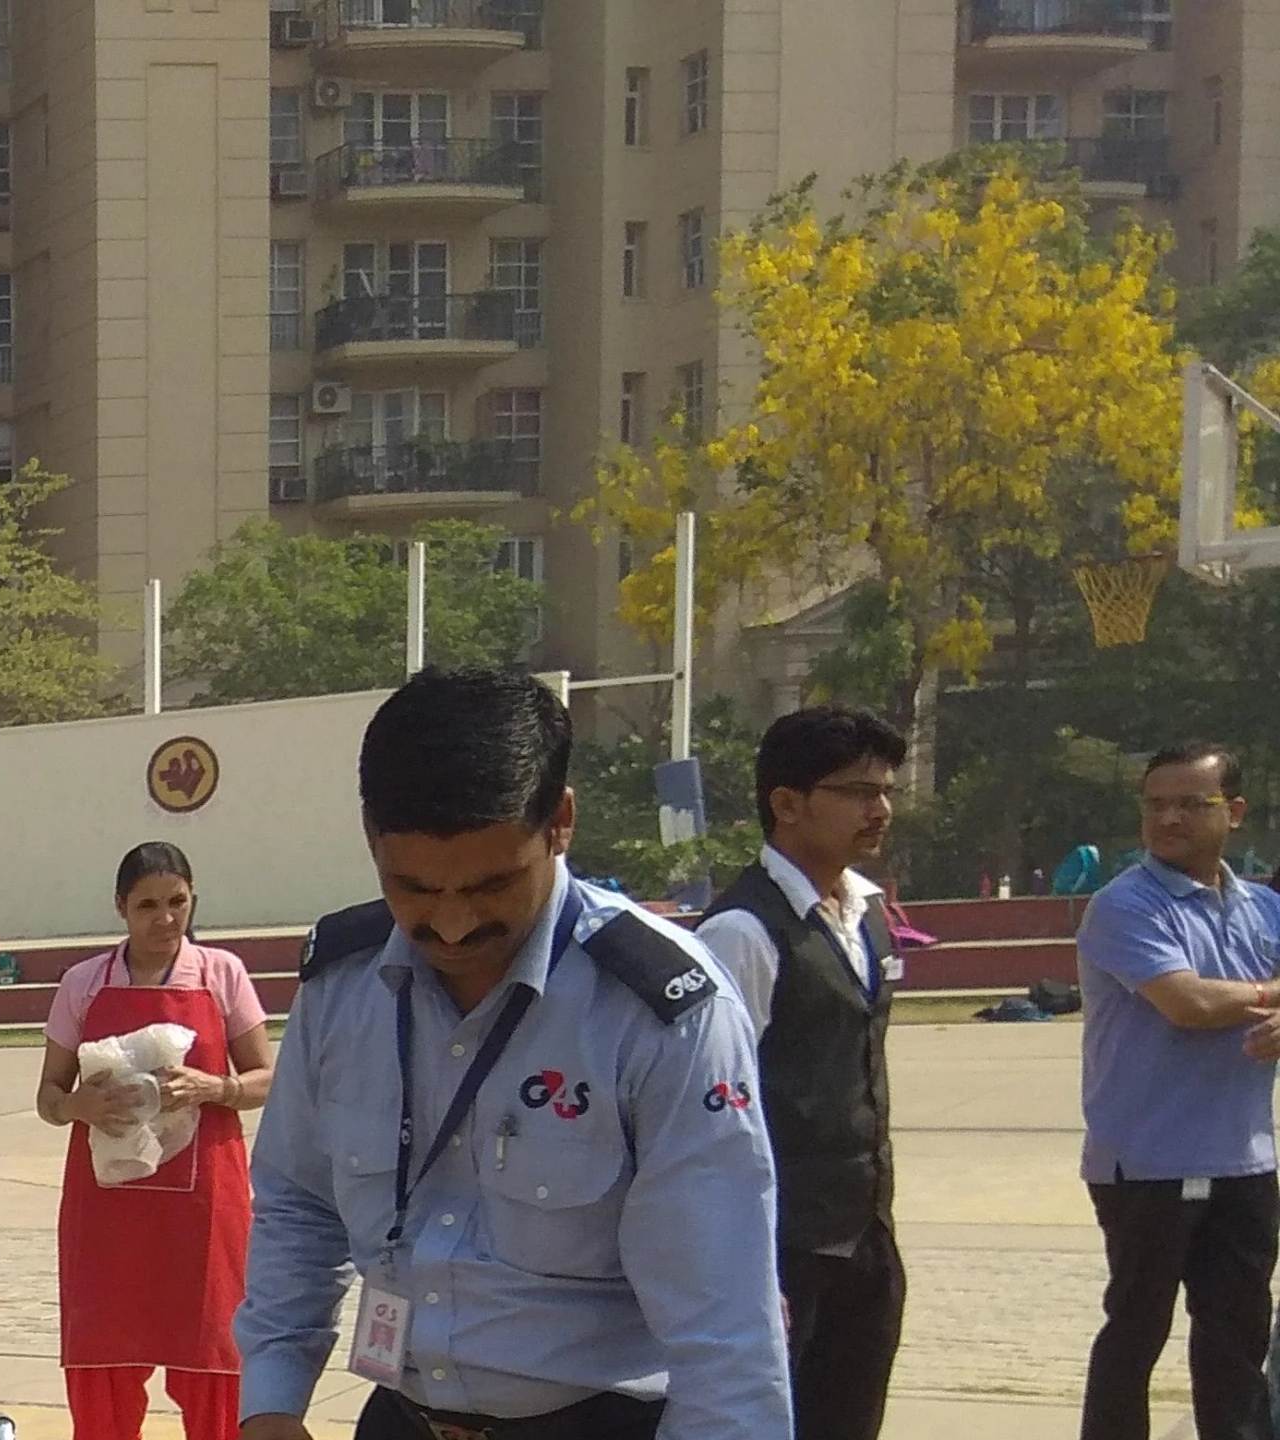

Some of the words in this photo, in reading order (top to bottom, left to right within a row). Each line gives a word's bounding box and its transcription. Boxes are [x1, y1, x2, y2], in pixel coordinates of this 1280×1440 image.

[664, 967, 707, 1000] G4S
[519, 1069, 591, 1119] G4S
[702, 1081, 751, 1113] G4S
